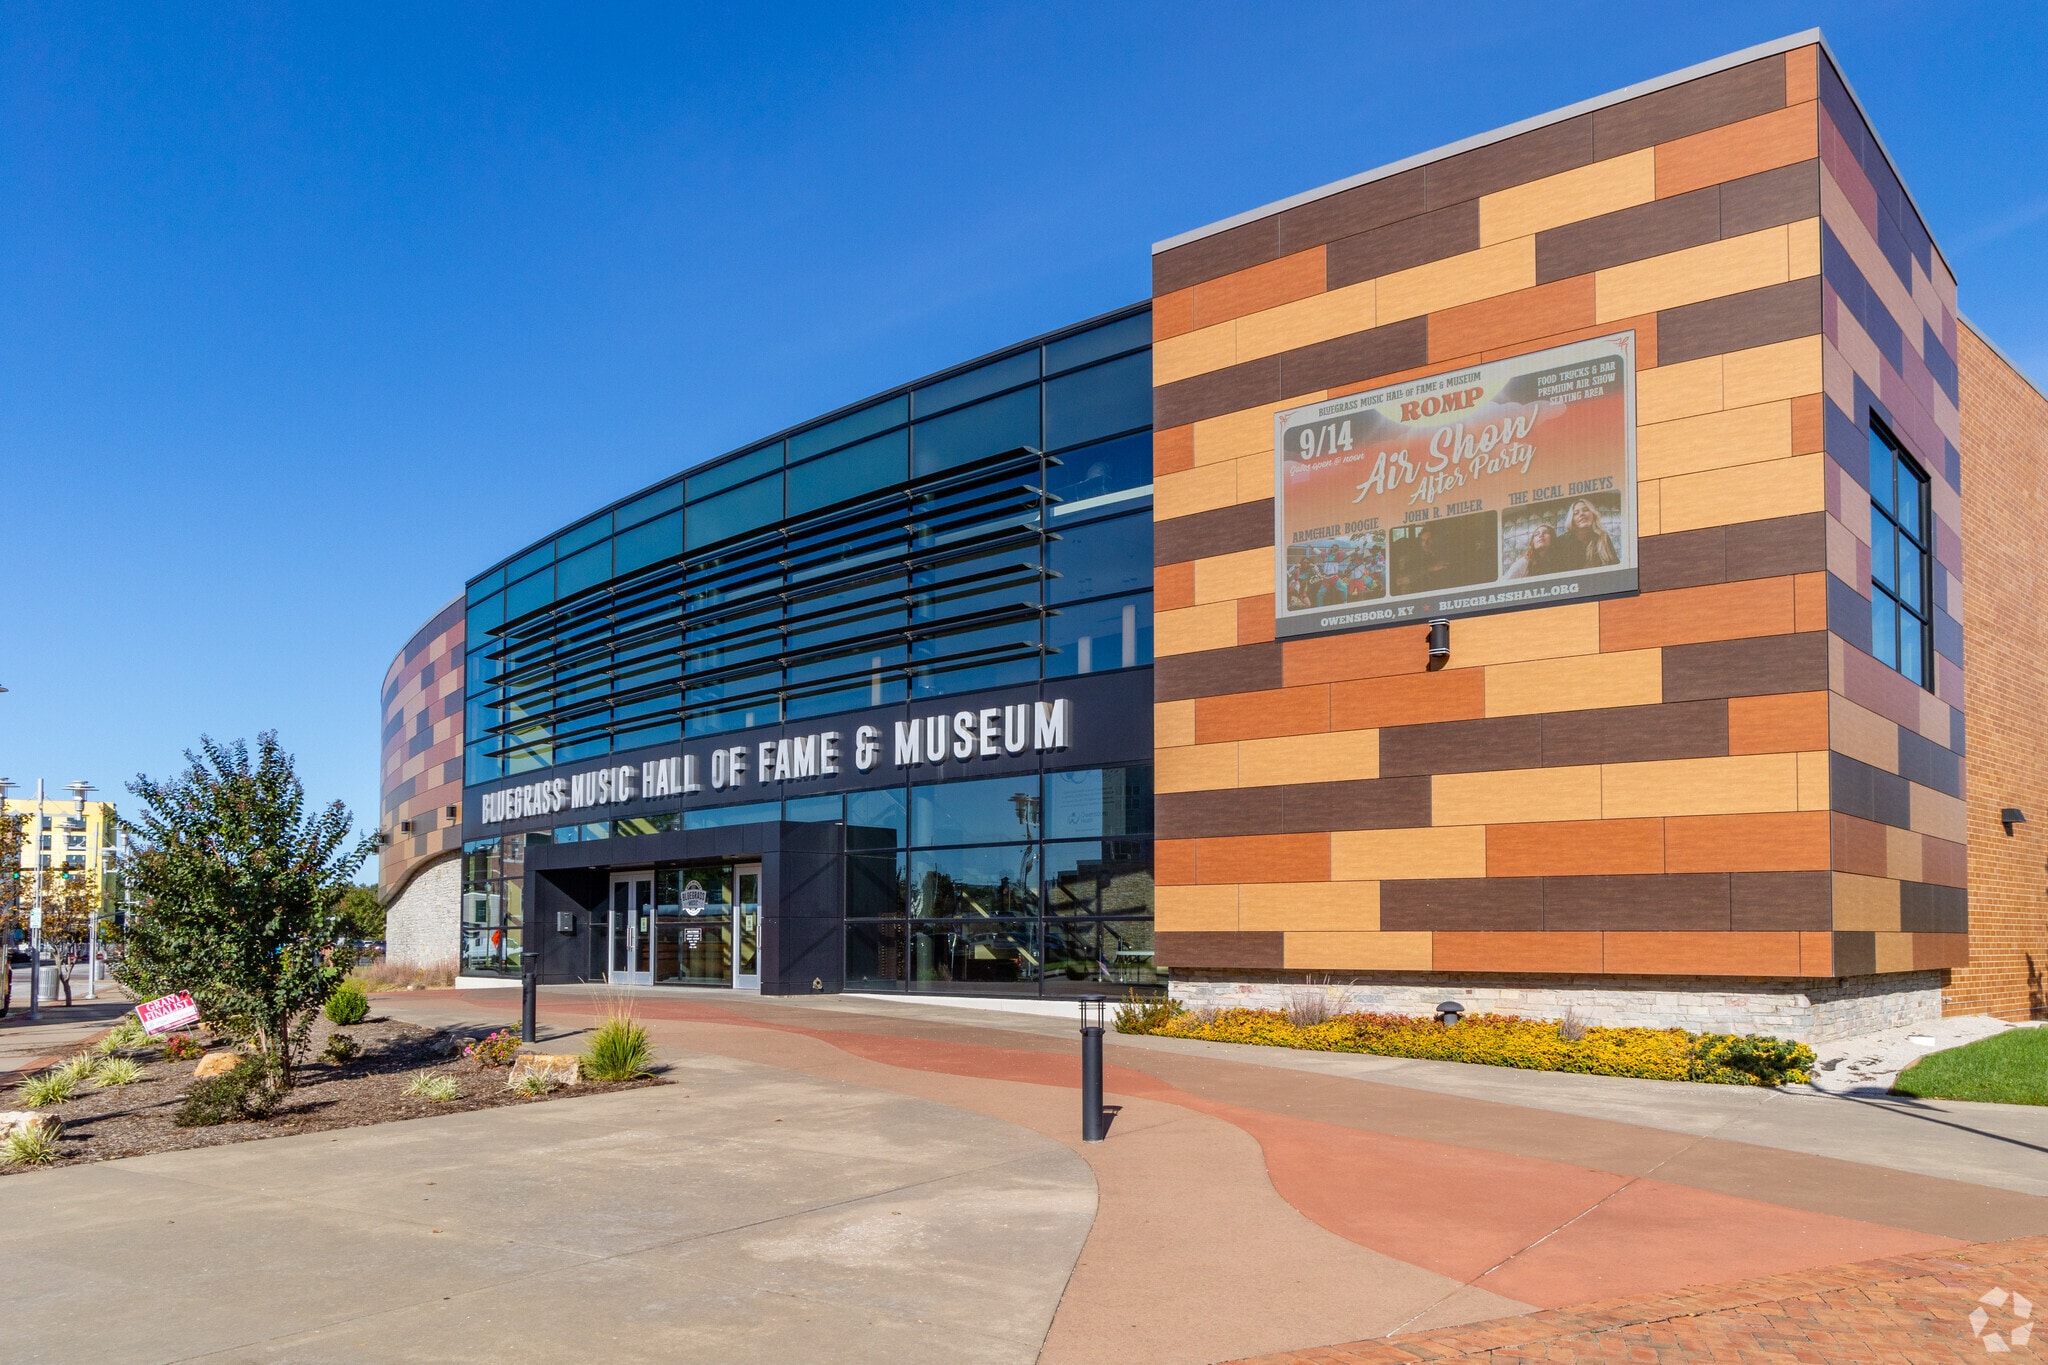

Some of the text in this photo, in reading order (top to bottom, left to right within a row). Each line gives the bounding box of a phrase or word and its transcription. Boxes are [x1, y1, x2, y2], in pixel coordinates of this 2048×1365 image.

[1537, 361, 1616, 387] FOOD TRUCKS & BAR
[1537, 372, 1616, 397] PREMIUM AIR SHOW
[1318, 371, 1482, 417] BLUEGRASS MUSIC HALL OF FAME & MUSEUM
[1400, 386, 1484, 422] ROMP
[1549, 386, 1604, 406] SEATING AREA
[1300, 420, 1353, 460] 9/14
[1352, 403, 1538, 504] Air Show
[1312, 459, 1333, 471] open
[1343, 453, 1365, 463] noon
[1408, 442, 1536, 505] After Party
[1508, 476, 1613, 505] THE LOCAL HONEYS
[1402, 499, 1483, 524] JOHN R. MILLER
[1292, 517, 1379, 543] ARMCHAIR BOOGIE
[1320, 583, 1579, 627] OWENSBORO, KY BLUEGRASSHALL.ORG
[482, 698, 1068, 824] BLUEGRASS MUSIC HALL OF FAME & MUSEUM
[682, 891, 705, 902] BLUEGRASS
[144, 1000, 189, 1020] FINALIST
